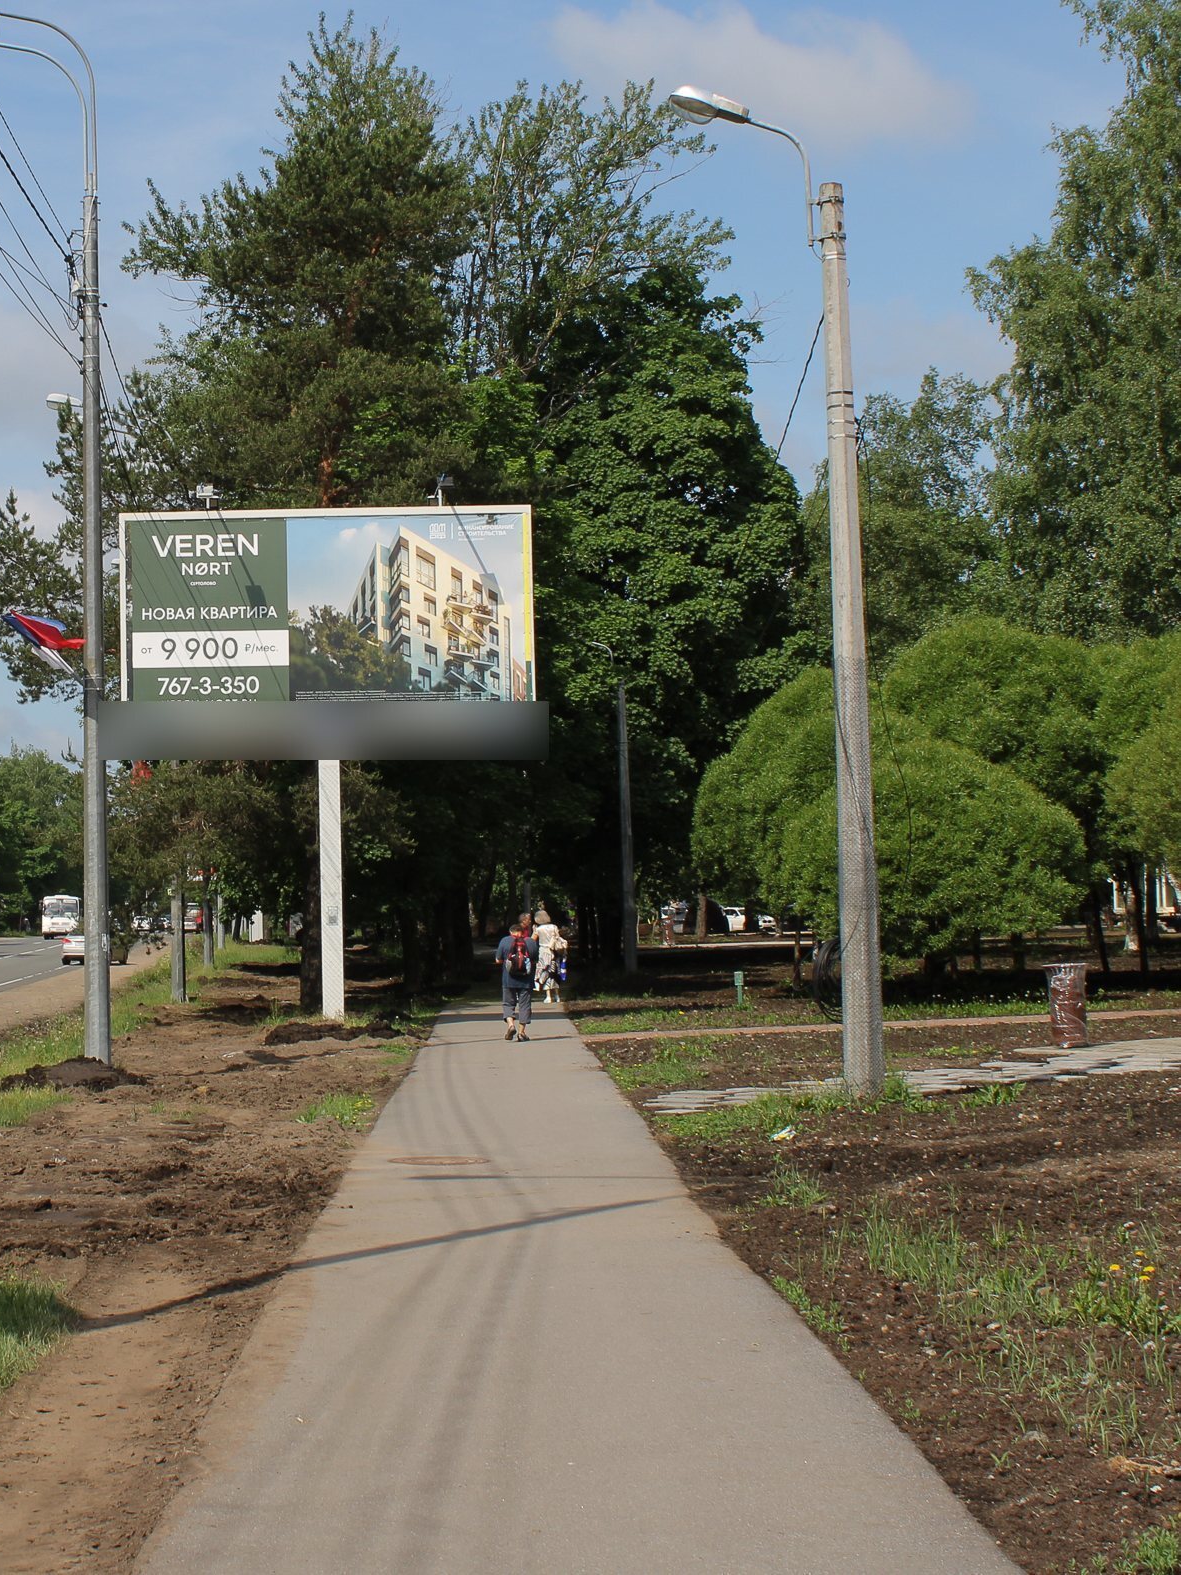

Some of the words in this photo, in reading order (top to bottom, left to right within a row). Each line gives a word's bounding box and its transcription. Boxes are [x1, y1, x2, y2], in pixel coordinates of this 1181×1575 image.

[152, 533, 258, 557] VEREN
[181, 562, 232, 576] NØRT
[141, 607, 195, 621] НОВАЯ
[200, 605, 278, 620] КВАРТИРА
[157, 675, 260, 696] 767-3-350
